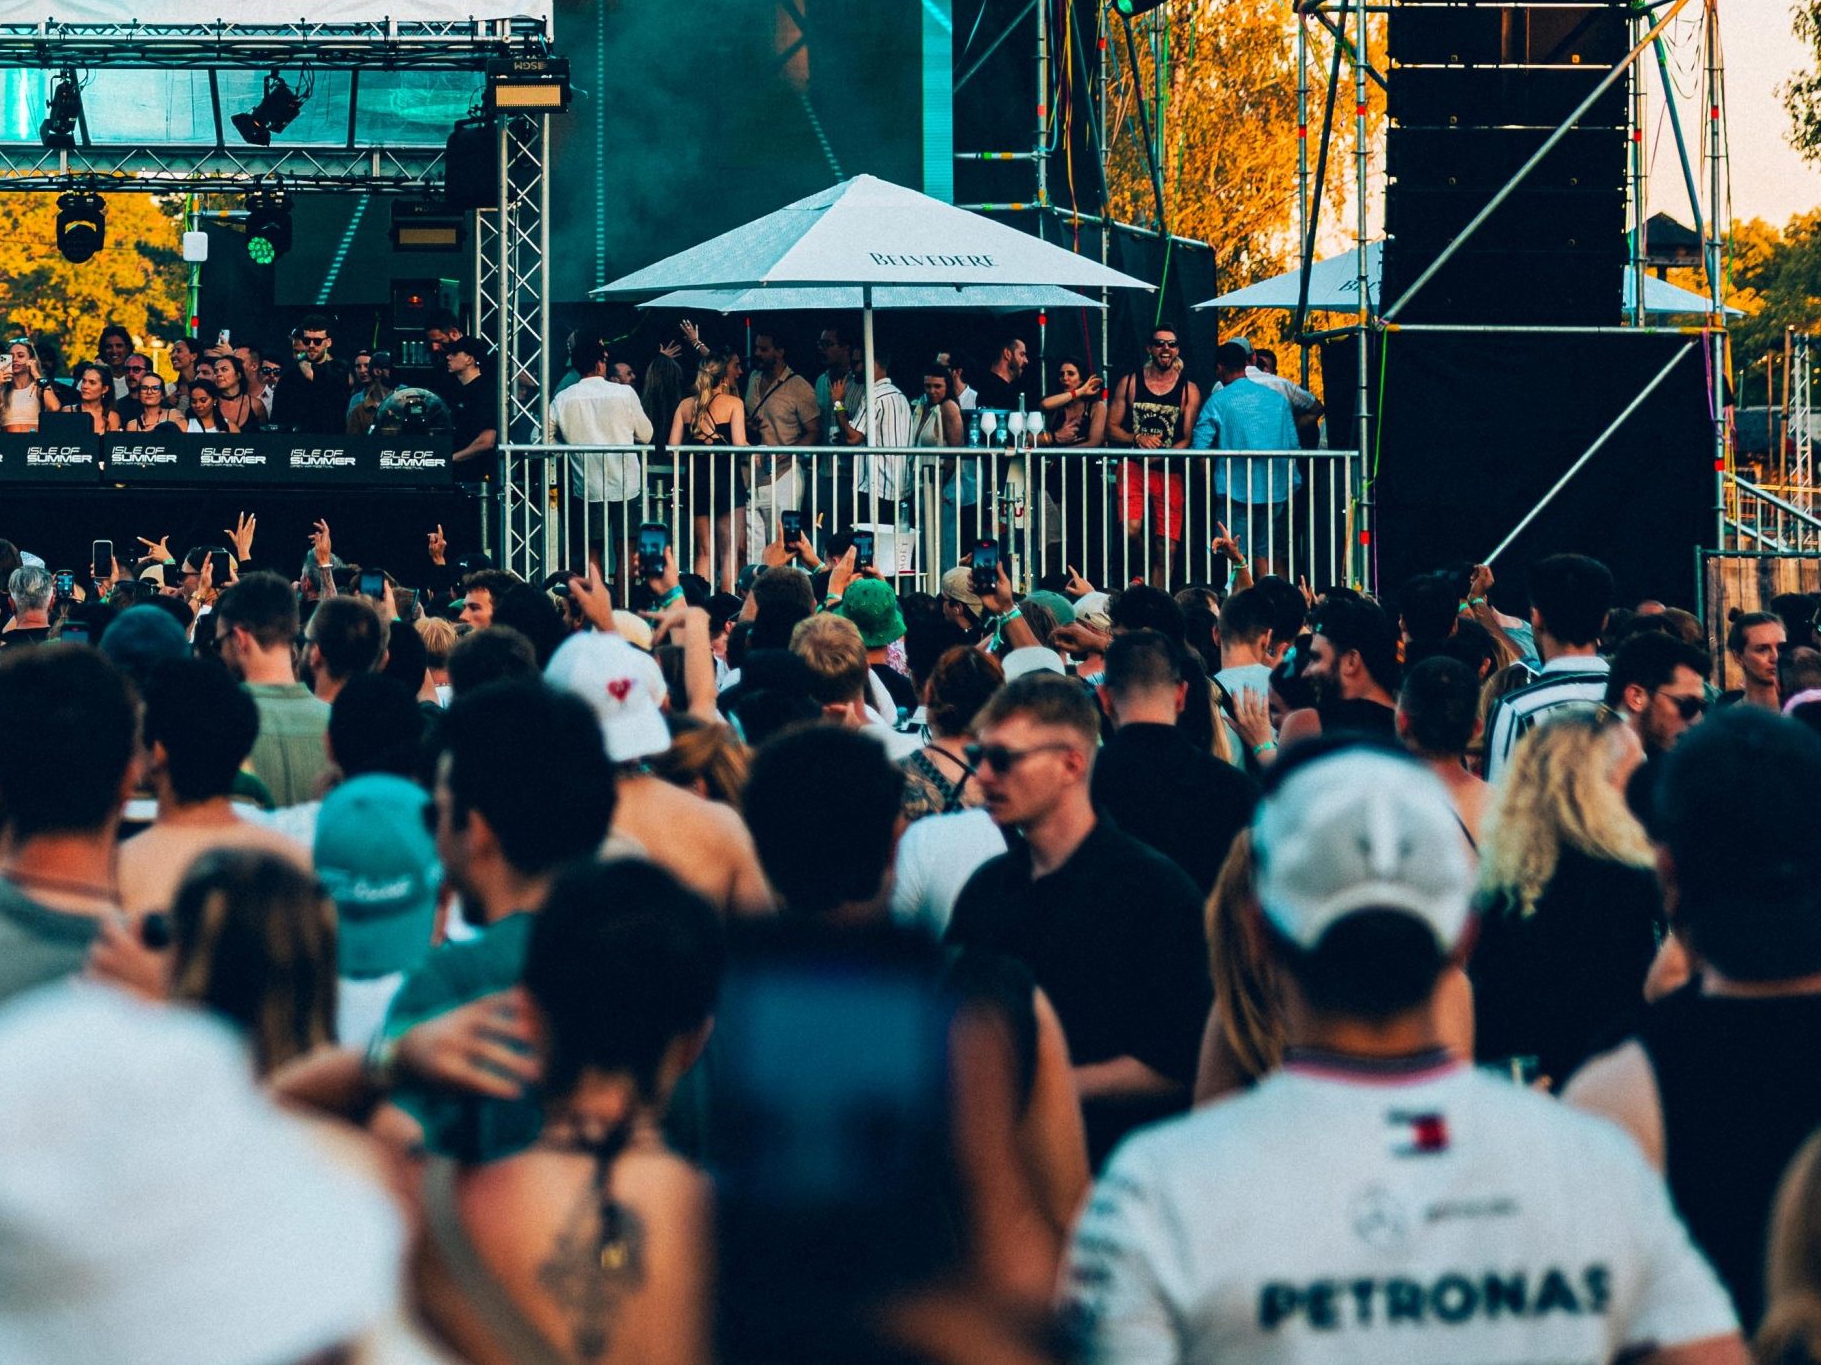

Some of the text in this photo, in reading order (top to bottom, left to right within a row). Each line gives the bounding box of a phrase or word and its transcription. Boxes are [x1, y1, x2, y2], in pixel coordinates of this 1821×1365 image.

[869, 252, 1000, 268] BELVEDERE
[27, 447, 80, 455] ISLE OF
[112, 446, 165, 455] ISLE OF
[201, 448, 254, 456] ISLE OF
[291, 449, 344, 458] ISLE OF
[27, 455, 92, 463] SUMMER
[112, 454, 177, 463] SUMMER
[414, 451, 433, 459] OF
[201, 456, 266, 464] SUMMER
[290, 457, 355, 465] SUMMER
[380, 459, 445, 467] SUMMER
[1259, 1263, 1611, 1330] PETRONAS
